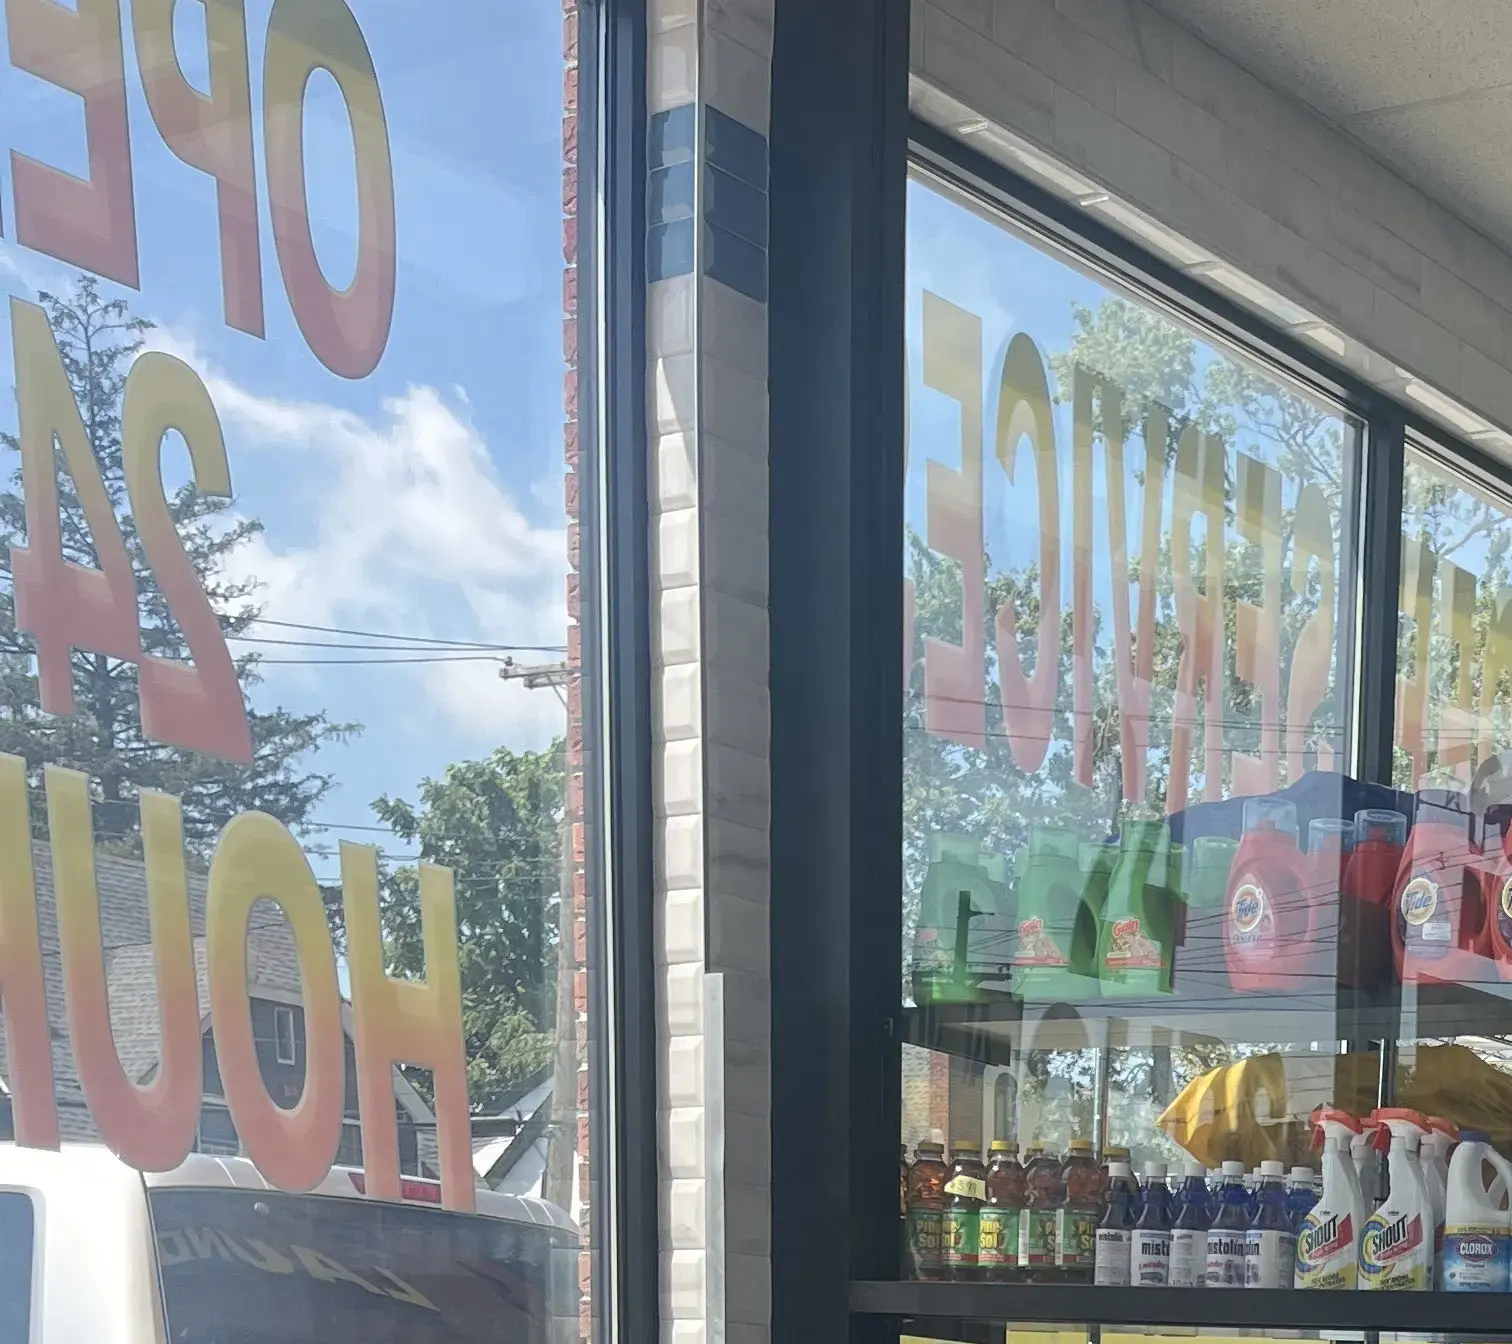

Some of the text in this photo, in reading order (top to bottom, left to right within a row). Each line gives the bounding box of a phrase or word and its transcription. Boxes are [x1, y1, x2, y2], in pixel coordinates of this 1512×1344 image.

[1404, 890, 1433, 912] Tide
[1305, 1215, 1338, 1254] SHOUT
[1371, 1215, 1408, 1254] SHOUT
[1459, 1241, 1493, 1256] CLOROX
